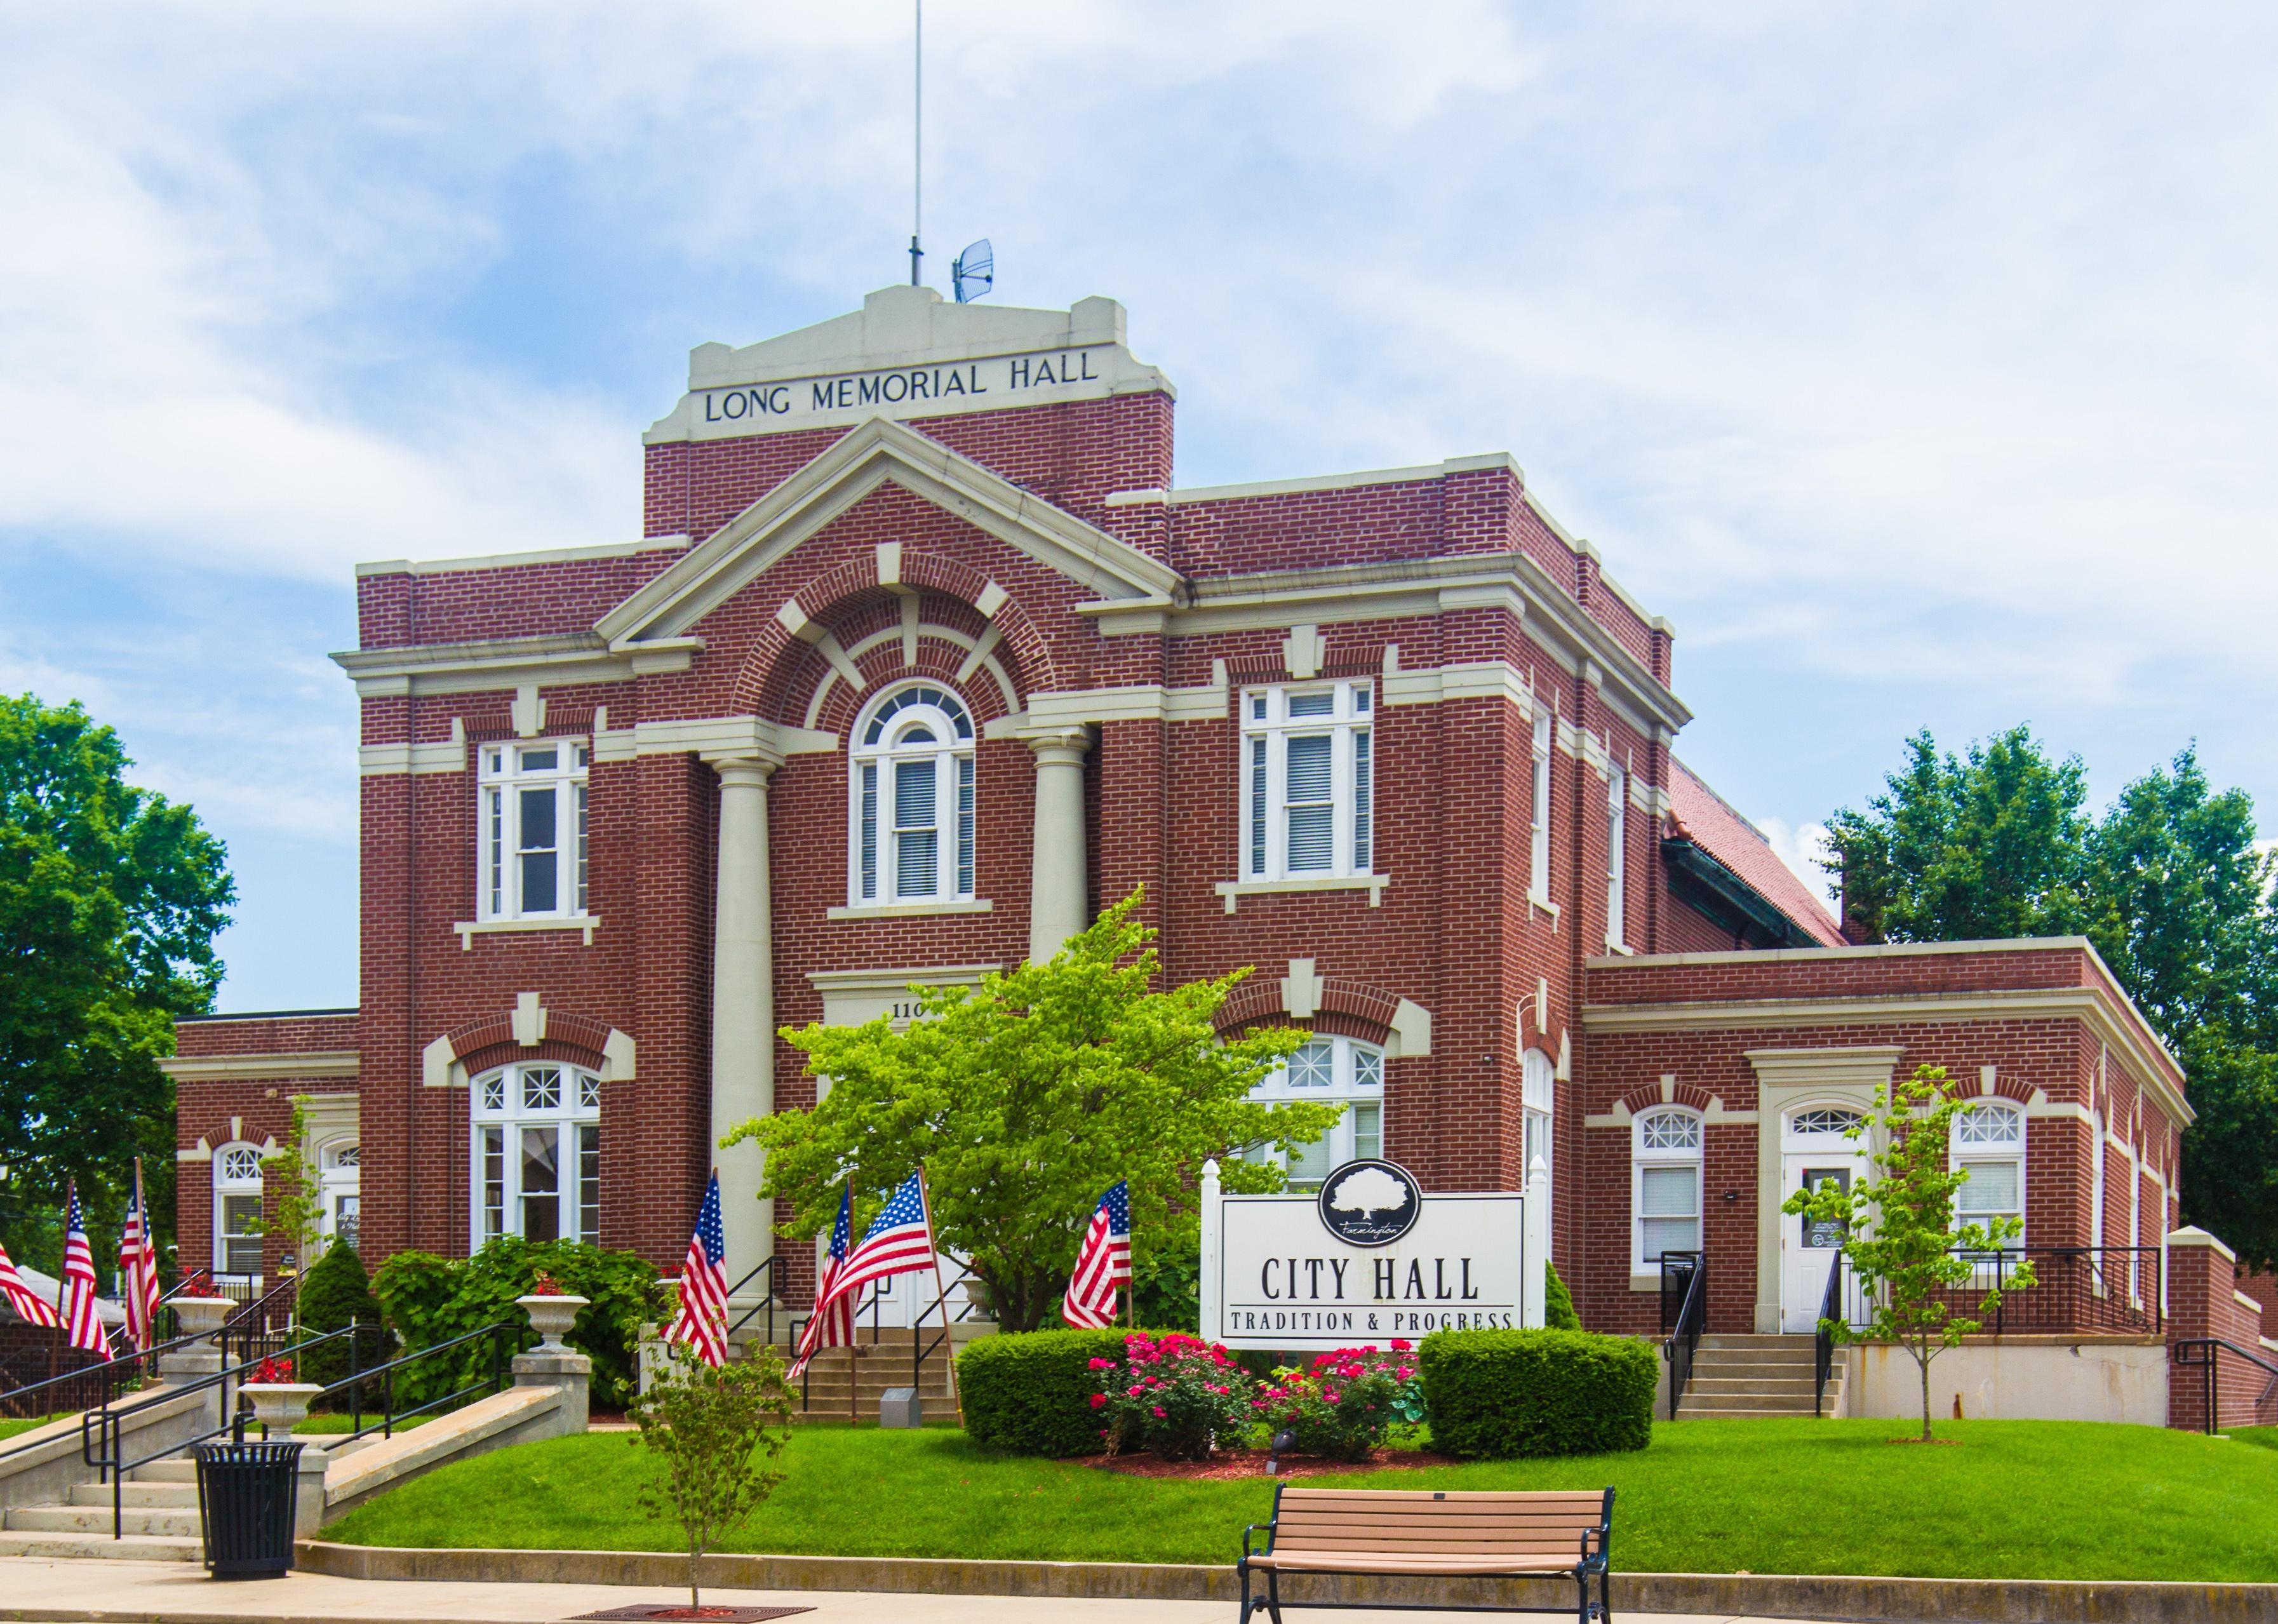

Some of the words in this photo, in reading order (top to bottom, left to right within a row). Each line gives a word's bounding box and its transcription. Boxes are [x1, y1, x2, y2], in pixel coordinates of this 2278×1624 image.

[706, 387, 790, 422] LONG
[812, 365, 988, 411] MEMORIAL
[1010, 352, 1099, 389] HALL
[1339, 1221, 1403, 1239] Farmington
[1261, 1258, 1350, 1299] CITY
[1373, 1257, 1479, 1299] HALL
[1231, 1312, 1353, 1331] TRADITION
[1368, 1312, 1379, 1331] &
[1394, 1313, 1511, 1331] PROGRESS
